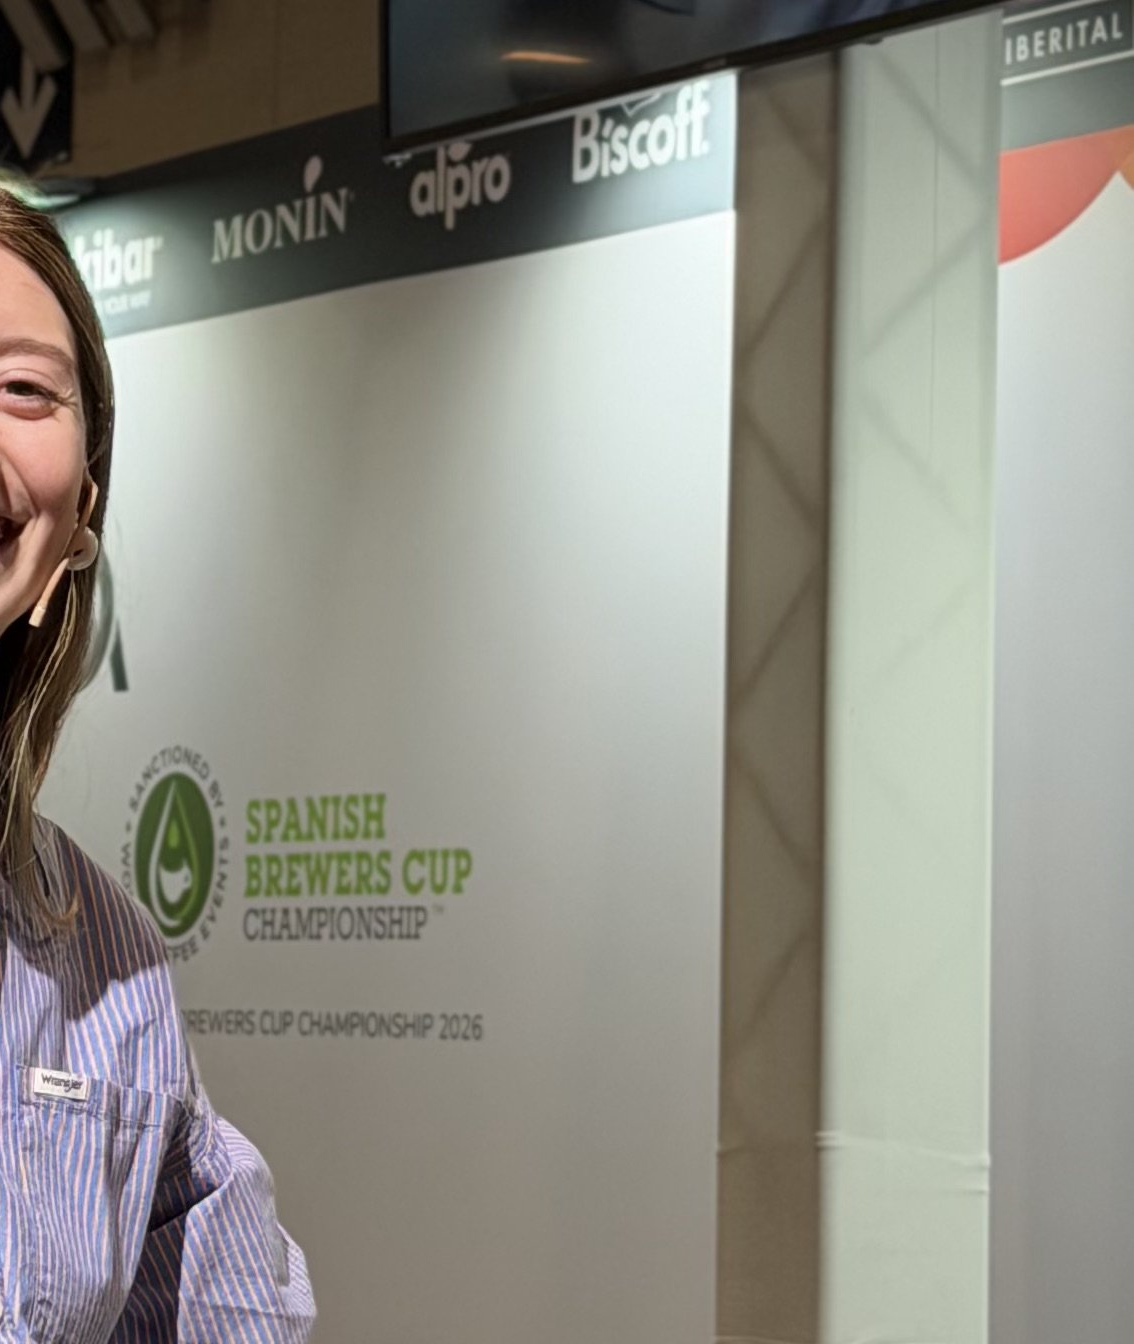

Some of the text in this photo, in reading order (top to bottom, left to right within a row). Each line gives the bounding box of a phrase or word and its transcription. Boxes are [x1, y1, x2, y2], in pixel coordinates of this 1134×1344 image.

[1004, 13, 1123, 65] IBERITAL
[572, 80, 708, 184] Biscoff
[211, 158, 350, 264] MONIN
[410, 143, 511, 231] alpro
[129, 745, 210, 812] SANCTIONED
[245, 794, 386, 844] SPANISH
[244, 848, 473, 898] BREWERS CUP
[243, 905, 429, 942] CHAMPIONSHIP
[259, 1009, 294, 1037] CUP
[297, 1010, 434, 1039] CHAMPIONSHIP
[439, 1013, 484, 1041] 2026
[41, 1072, 83, 1093] Wrangler
